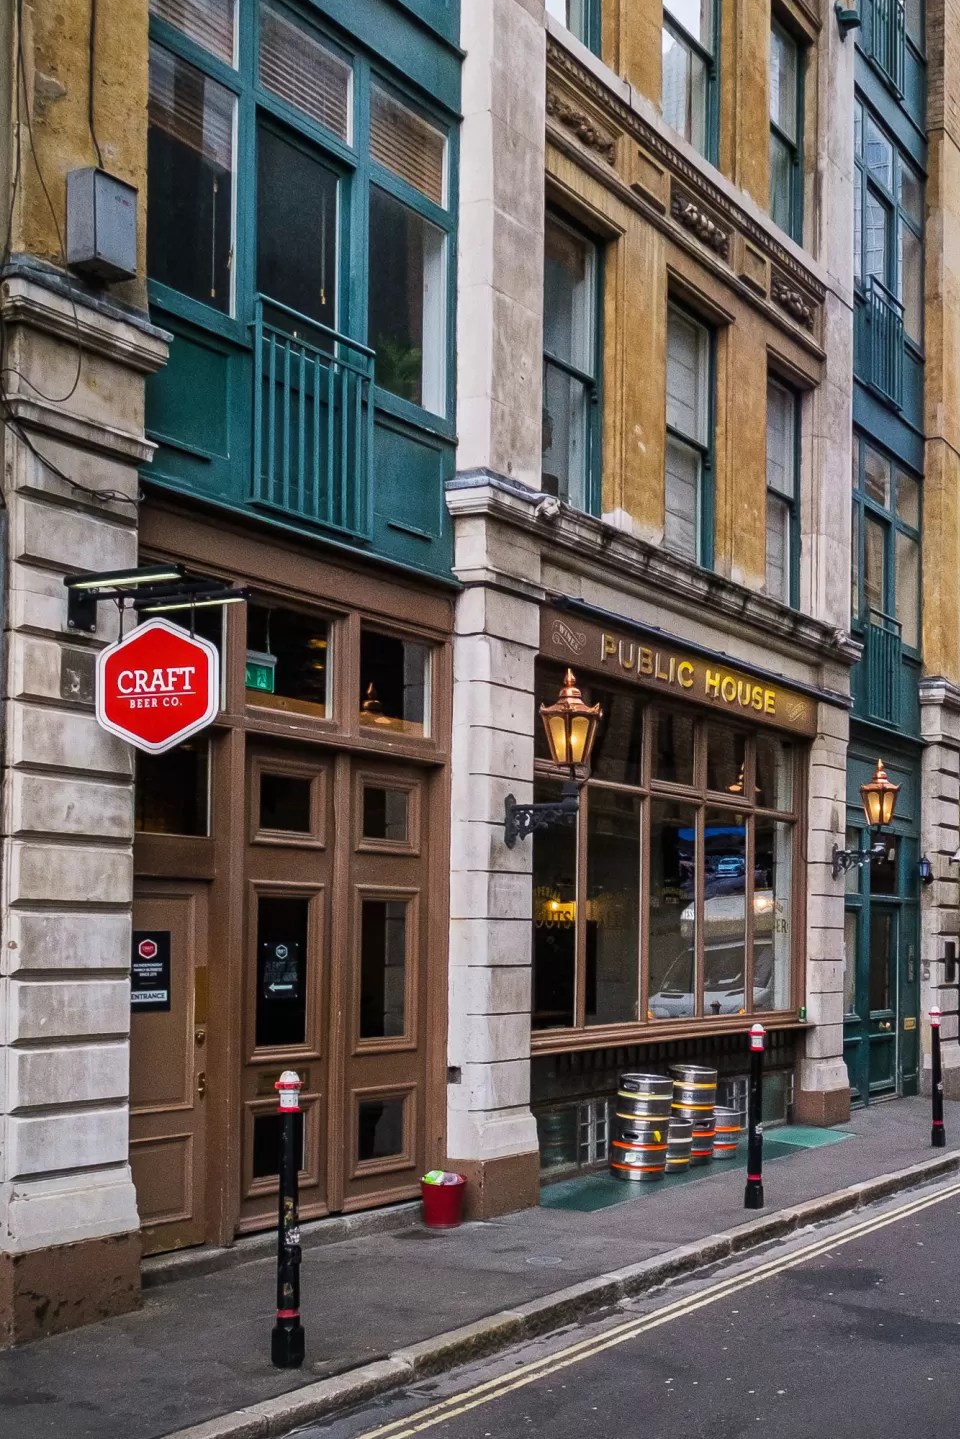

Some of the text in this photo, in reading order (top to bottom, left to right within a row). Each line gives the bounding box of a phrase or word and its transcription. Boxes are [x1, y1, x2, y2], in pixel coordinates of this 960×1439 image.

[558, 622, 579, 651] WINES
[117, 666, 196, 694] CRAFT
[600, 632, 776, 715] PUBLIC HOUSE
[129, 696, 183, 709] BEER CO.
[131, 992, 165, 1000] ENTRANCE
